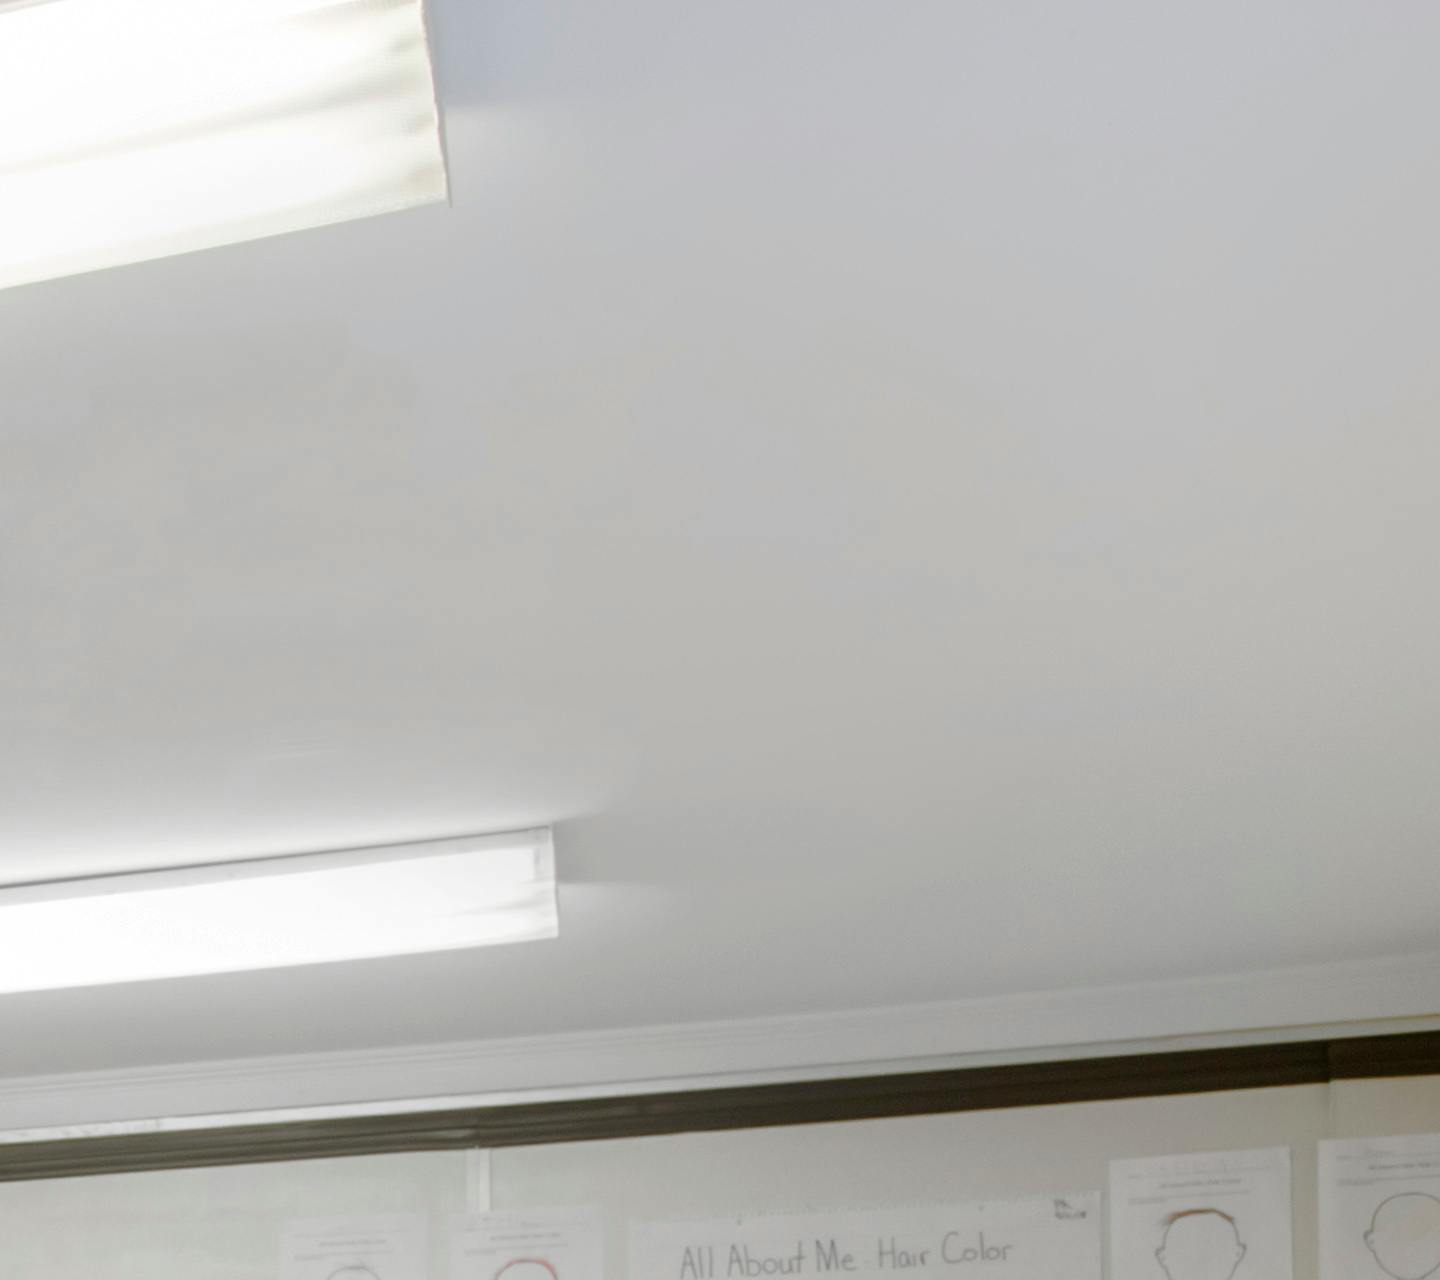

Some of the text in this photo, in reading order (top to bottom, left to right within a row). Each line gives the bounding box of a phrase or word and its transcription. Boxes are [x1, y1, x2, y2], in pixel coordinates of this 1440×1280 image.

[679, 1230, 1015, 1280] All About Me Hair Color
